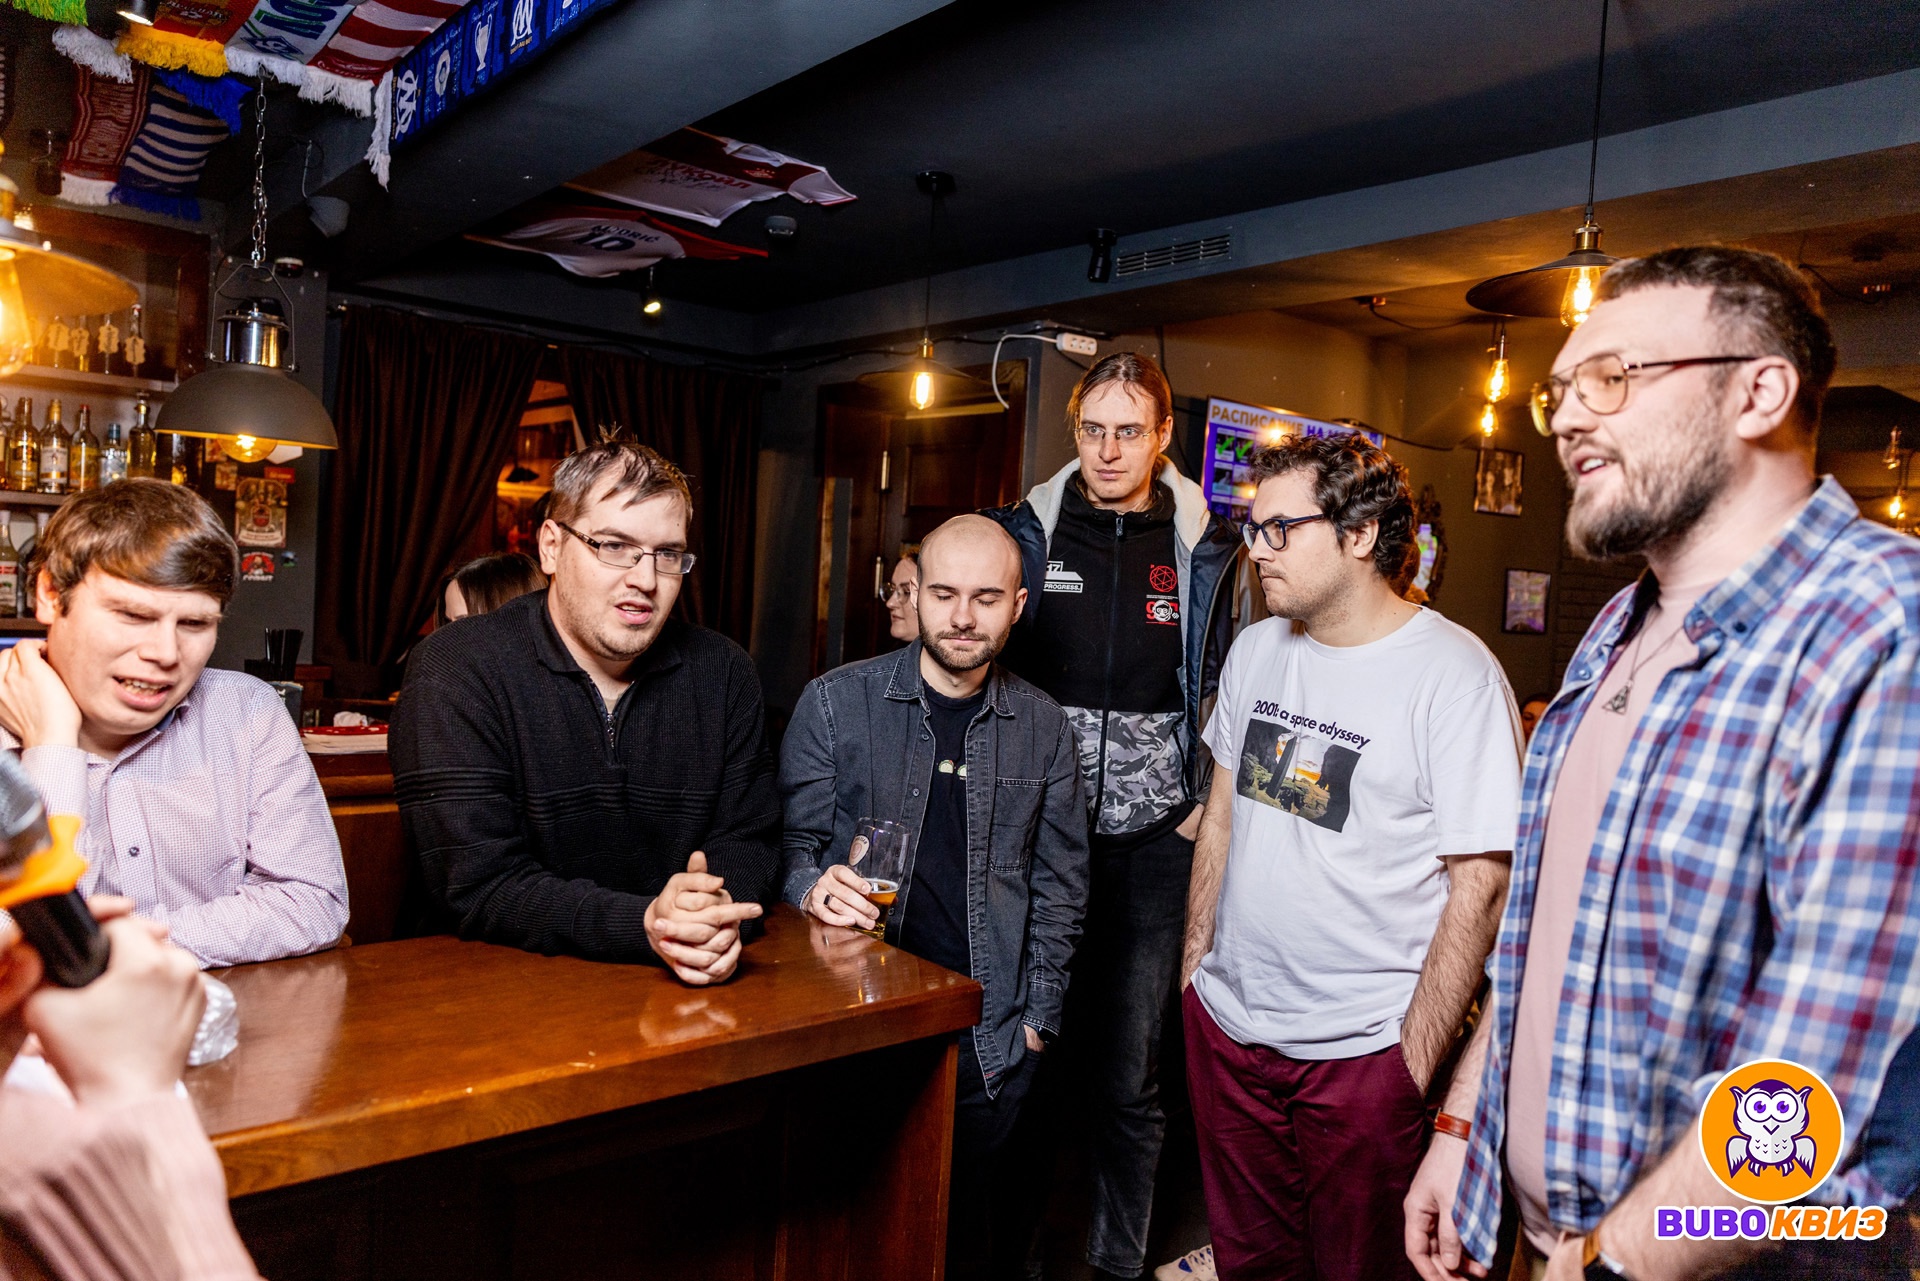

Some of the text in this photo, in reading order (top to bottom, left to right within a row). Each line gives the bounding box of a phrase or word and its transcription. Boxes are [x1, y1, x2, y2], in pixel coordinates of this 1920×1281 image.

[574, 233, 635, 251] 10
[1211, 405, 1304, 436] РАСПИСАНИЕ
[1046, 563, 1061, 572] 17
[1279, 709, 1290, 720] a
[1318, 721, 1371, 750] odyssey
